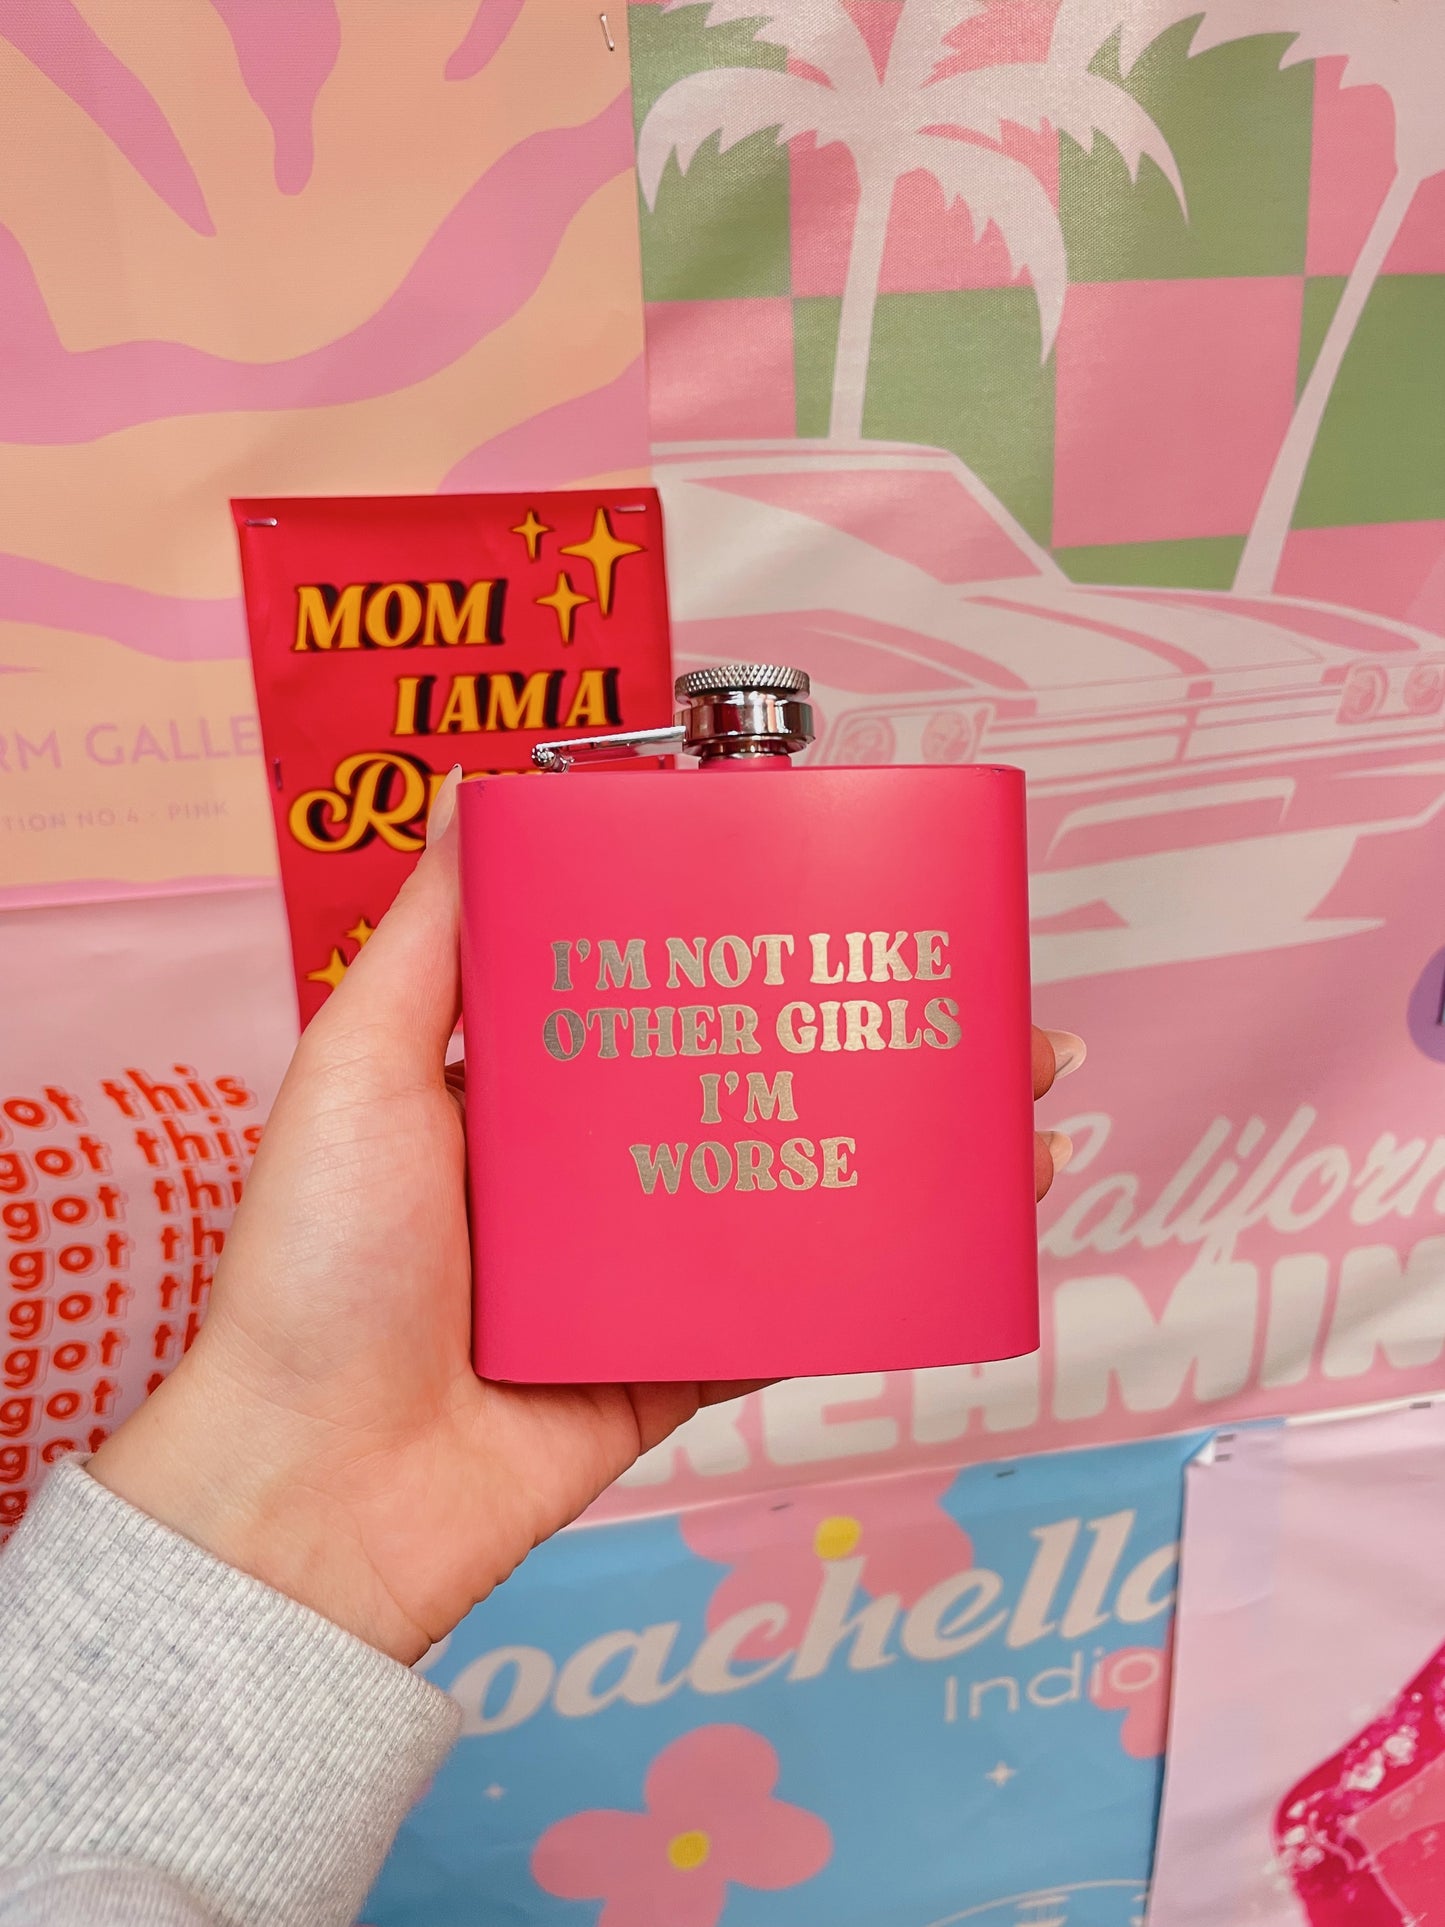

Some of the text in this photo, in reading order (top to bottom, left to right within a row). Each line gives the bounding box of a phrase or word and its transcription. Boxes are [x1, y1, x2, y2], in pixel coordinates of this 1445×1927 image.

[291, 578, 507, 652] MOM
[393, 667, 622, 735] I AM A
[85, 714, 264, 767] GALLE
[551, 930, 952, 991] I'M NOT LIKE
[543, 997, 962, 1061] OTHER GIRLS
[0, 1063, 251, 1140] ot this
[699, 1070, 799, 1124] I'M
[629, 1136, 858, 1195] WORSE
[1, 1164, 243, 1243] got thi
[8, 1216, 226, 1292] got th
[8, 1281, 126, 1342] got
[3, 1330, 121, 1390] got
[0, 1380, 113, 1438] got
[944, 1646, 1161, 1723] Indio
